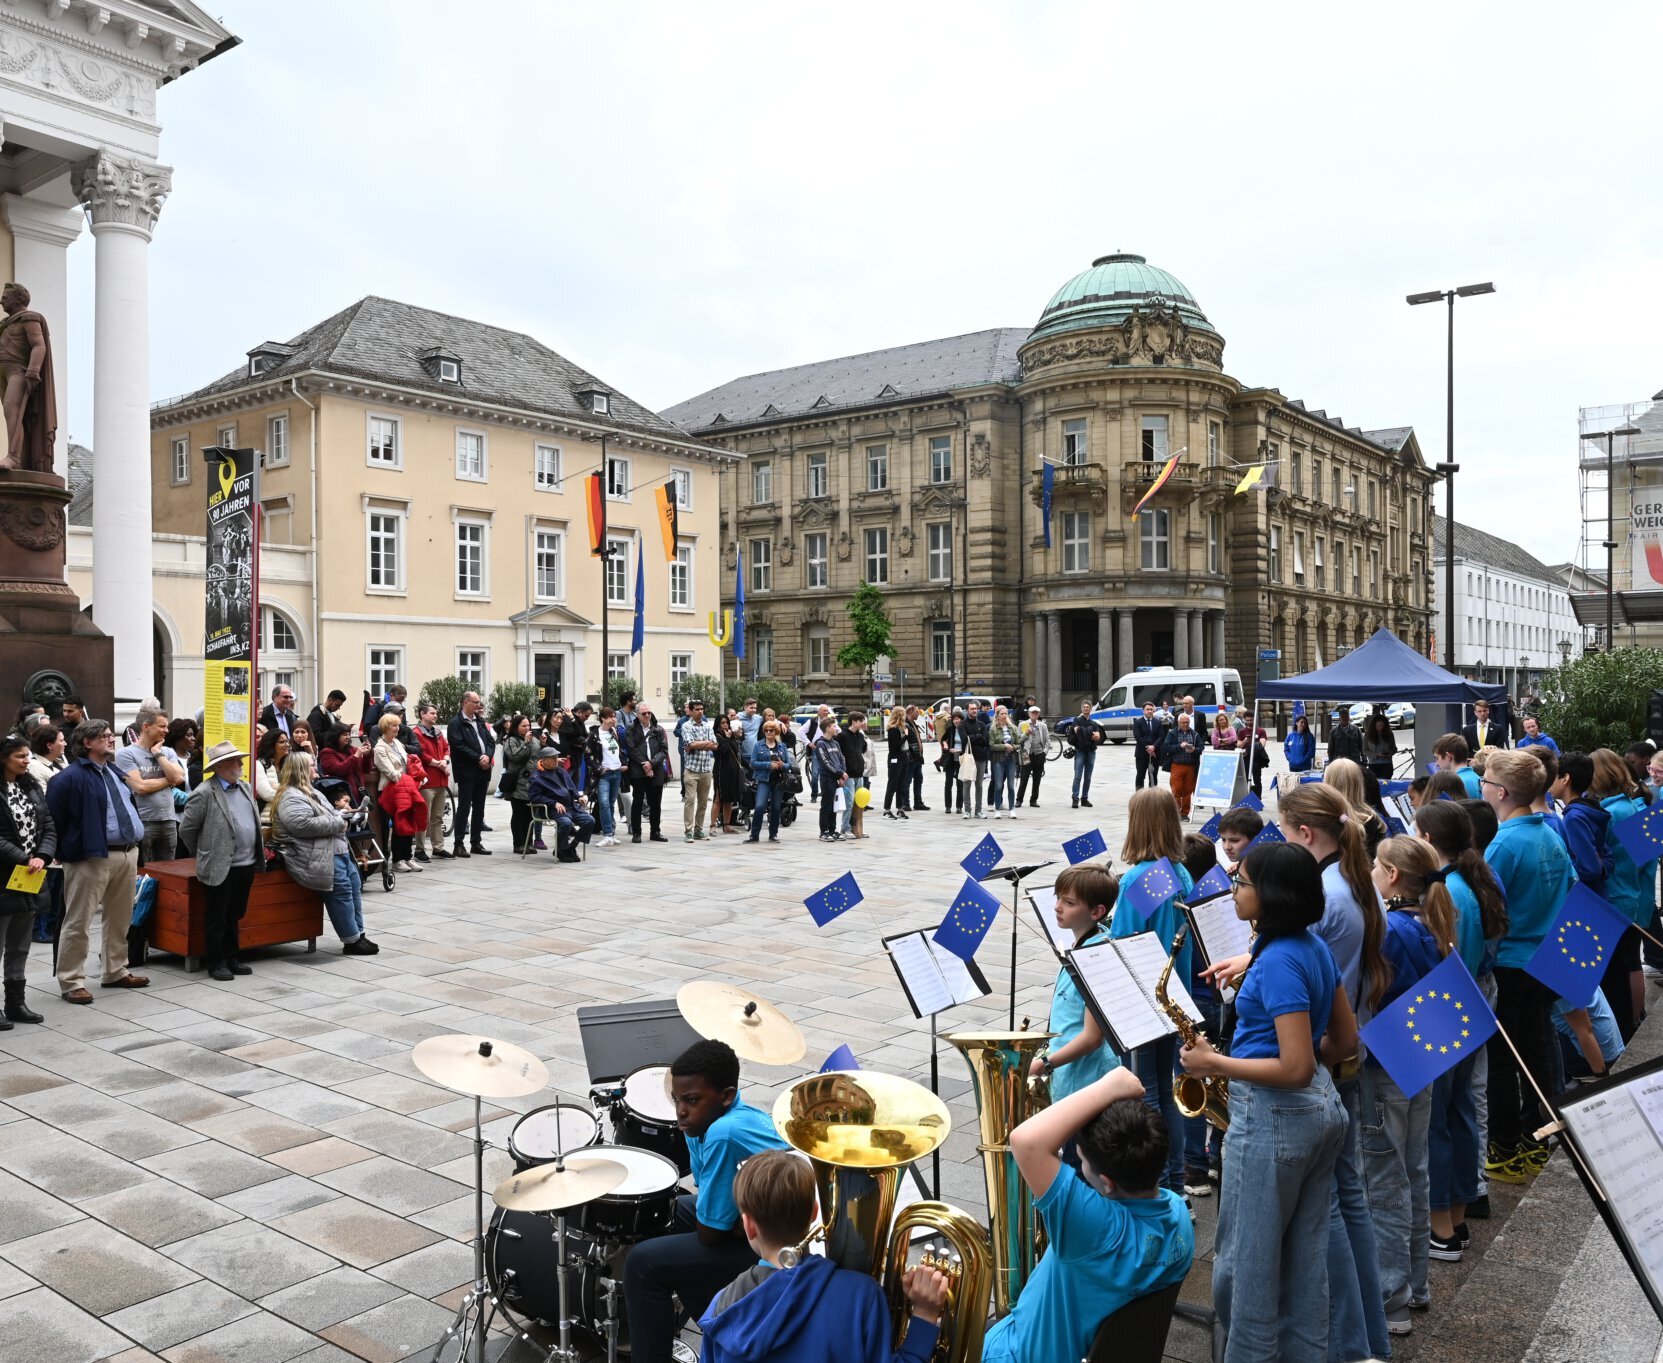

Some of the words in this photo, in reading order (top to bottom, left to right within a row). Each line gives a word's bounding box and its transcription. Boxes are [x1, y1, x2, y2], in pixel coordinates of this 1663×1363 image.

[209, 490, 223, 507] HIER
[233, 478, 250, 494] VOR
[212, 507, 220, 521] 90
[220, 495, 250, 517] JAHREN
[1633, 532, 1659, 541] FAIR
[708, 609, 734, 647] U
[206, 634, 237, 654] SCHAUFAHRT
[229, 643, 241, 655] INS
[241, 640, 250, 652] KZ
